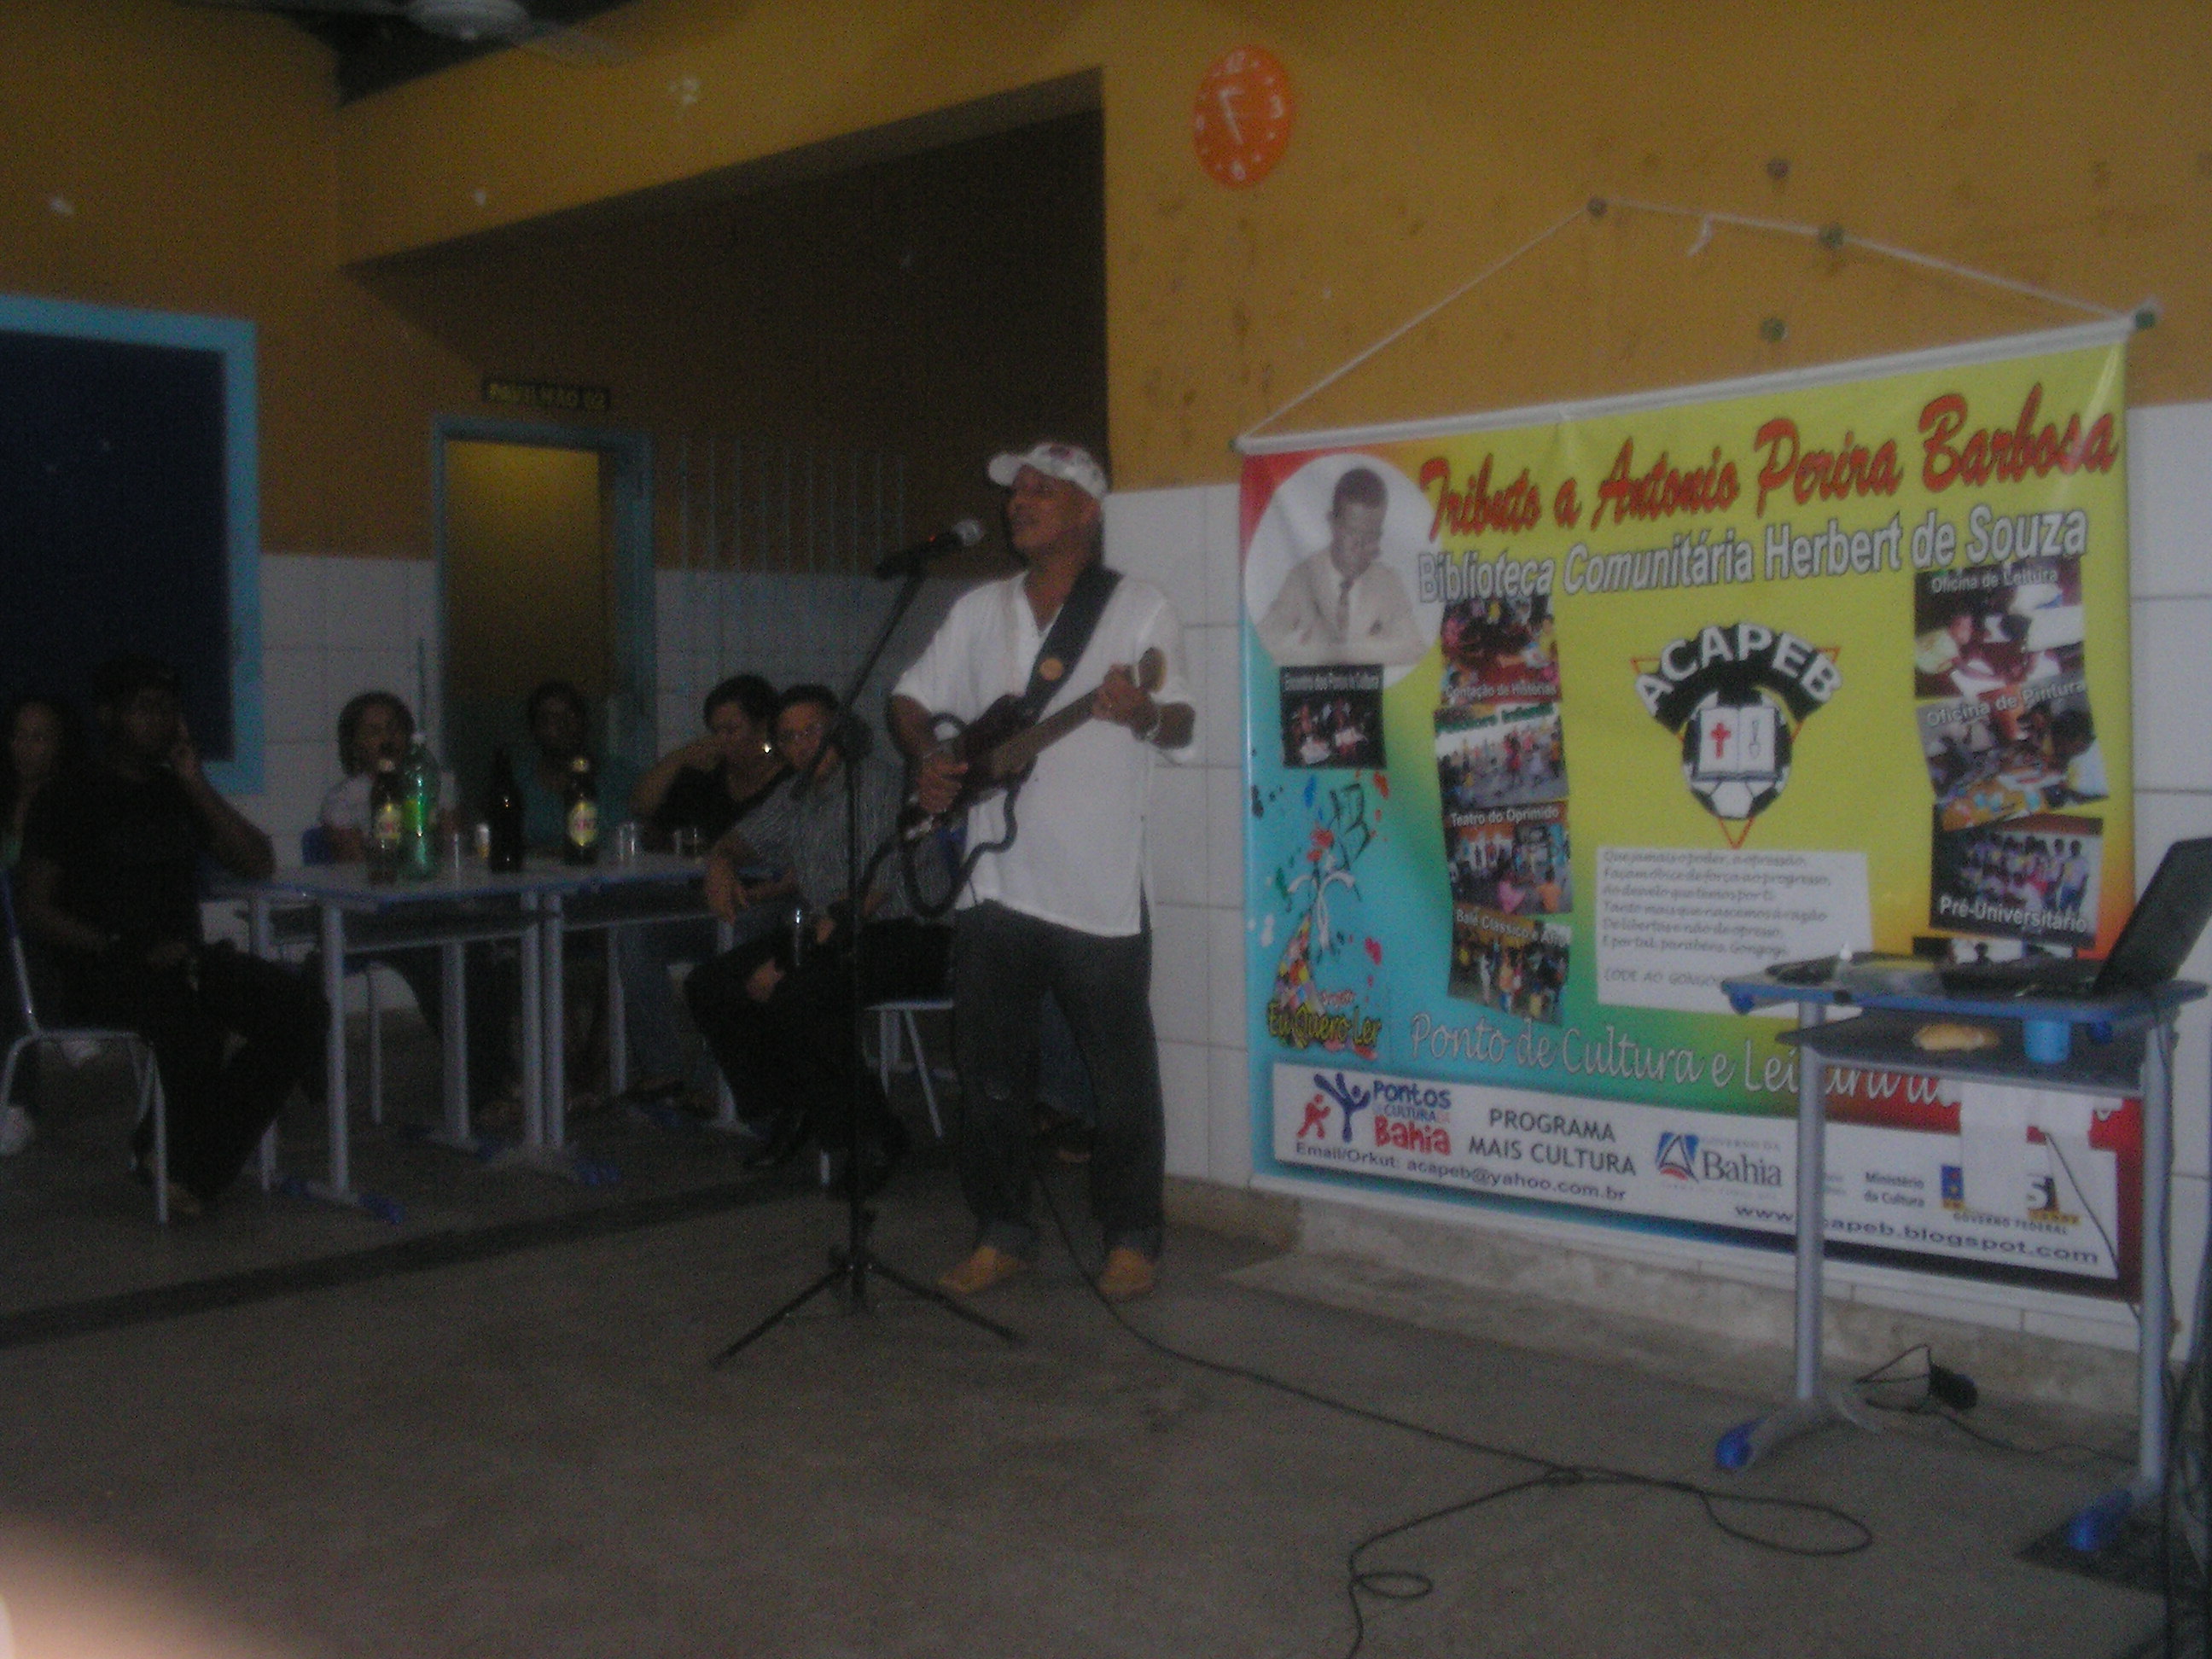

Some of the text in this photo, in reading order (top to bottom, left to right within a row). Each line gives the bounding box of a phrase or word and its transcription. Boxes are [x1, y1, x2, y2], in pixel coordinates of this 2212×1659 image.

[1418, 452, 1541, 544] Tributo
[1553, 477, 1582, 530] a
[1590, 436, 1741, 532] Antonio
[1917, 382, 2119, 493] Barbosa
[1417, 503, 2089, 603] Biblioteca Comunitária Herbert de Souza
[1930, 574, 1978, 593] Oficina
[1982, 571, 2000, 588] de
[1634, 621, 1843, 717] ACAPEB
[1927, 700, 1990, 726] Oficina
[1994, 694, 2017, 711] de
[1451, 811, 1486, 827] Teatro
[1411, 1012, 1511, 1063] Ponto
[1515, 1016, 1558, 1070] de
[1562, 1025, 1706, 1083] Cultura
[1710, 1051, 1738, 1089] e
[1372, 1079, 1452, 1111] Pontos
[1383, 1104, 1437, 1123] CULTURA
[1374, 1114, 1452, 1158] Bahia
[1488, 1107, 1617, 1144] PROGRAMA
[1295, 1140, 1627, 1202] Email/Orkut: acapeb@yahoo.com.br
[1468, 1135, 1637, 1178] MAIS CULTURA
[1702, 1148, 1783, 1187] Bahia
[1953, 1211, 2011, 1229] GOVERNO
[2014, 1218, 2068, 1236] FEDERAL
